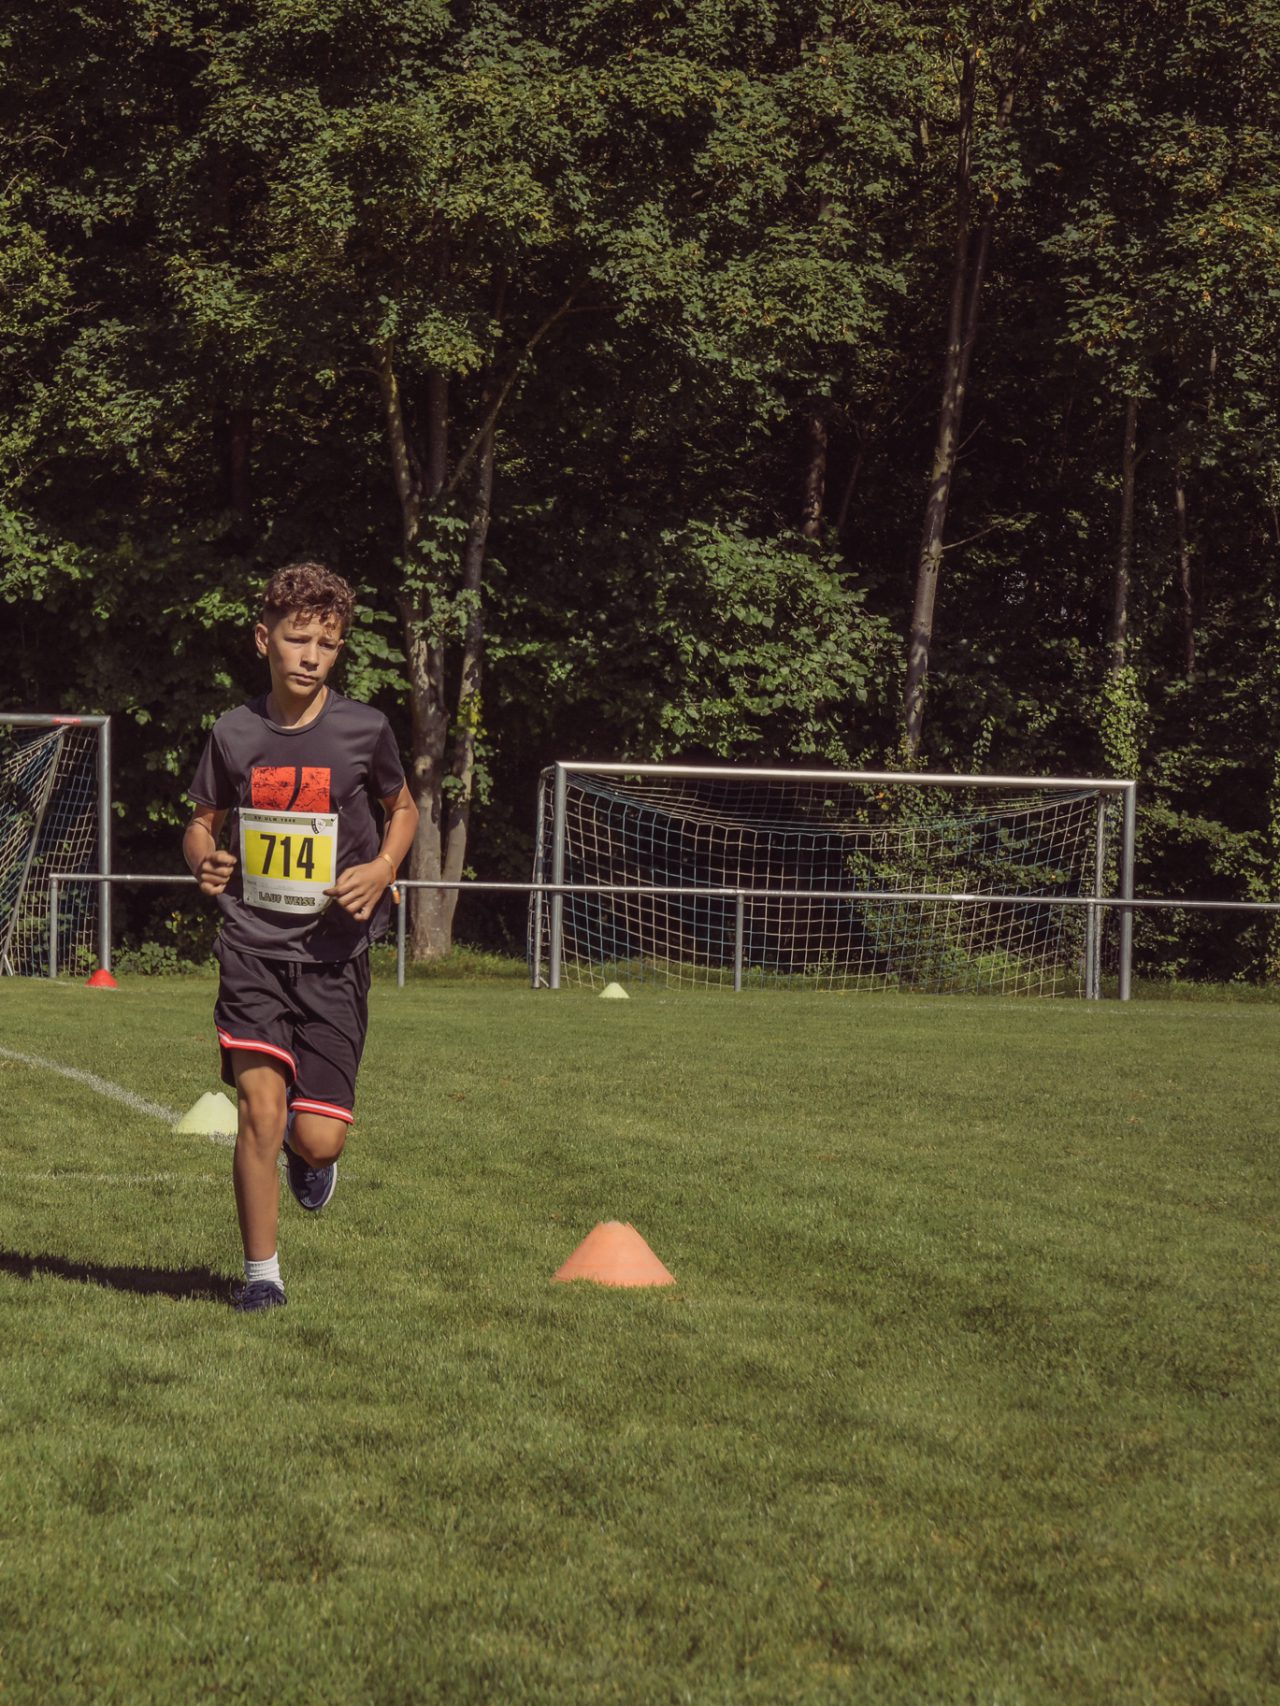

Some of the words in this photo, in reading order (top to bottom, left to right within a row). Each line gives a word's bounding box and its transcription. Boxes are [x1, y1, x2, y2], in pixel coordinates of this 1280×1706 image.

[260, 834, 315, 879] 714
[258, 891, 282, 904] LAUF
[283, 895, 315, 907] WEISE
